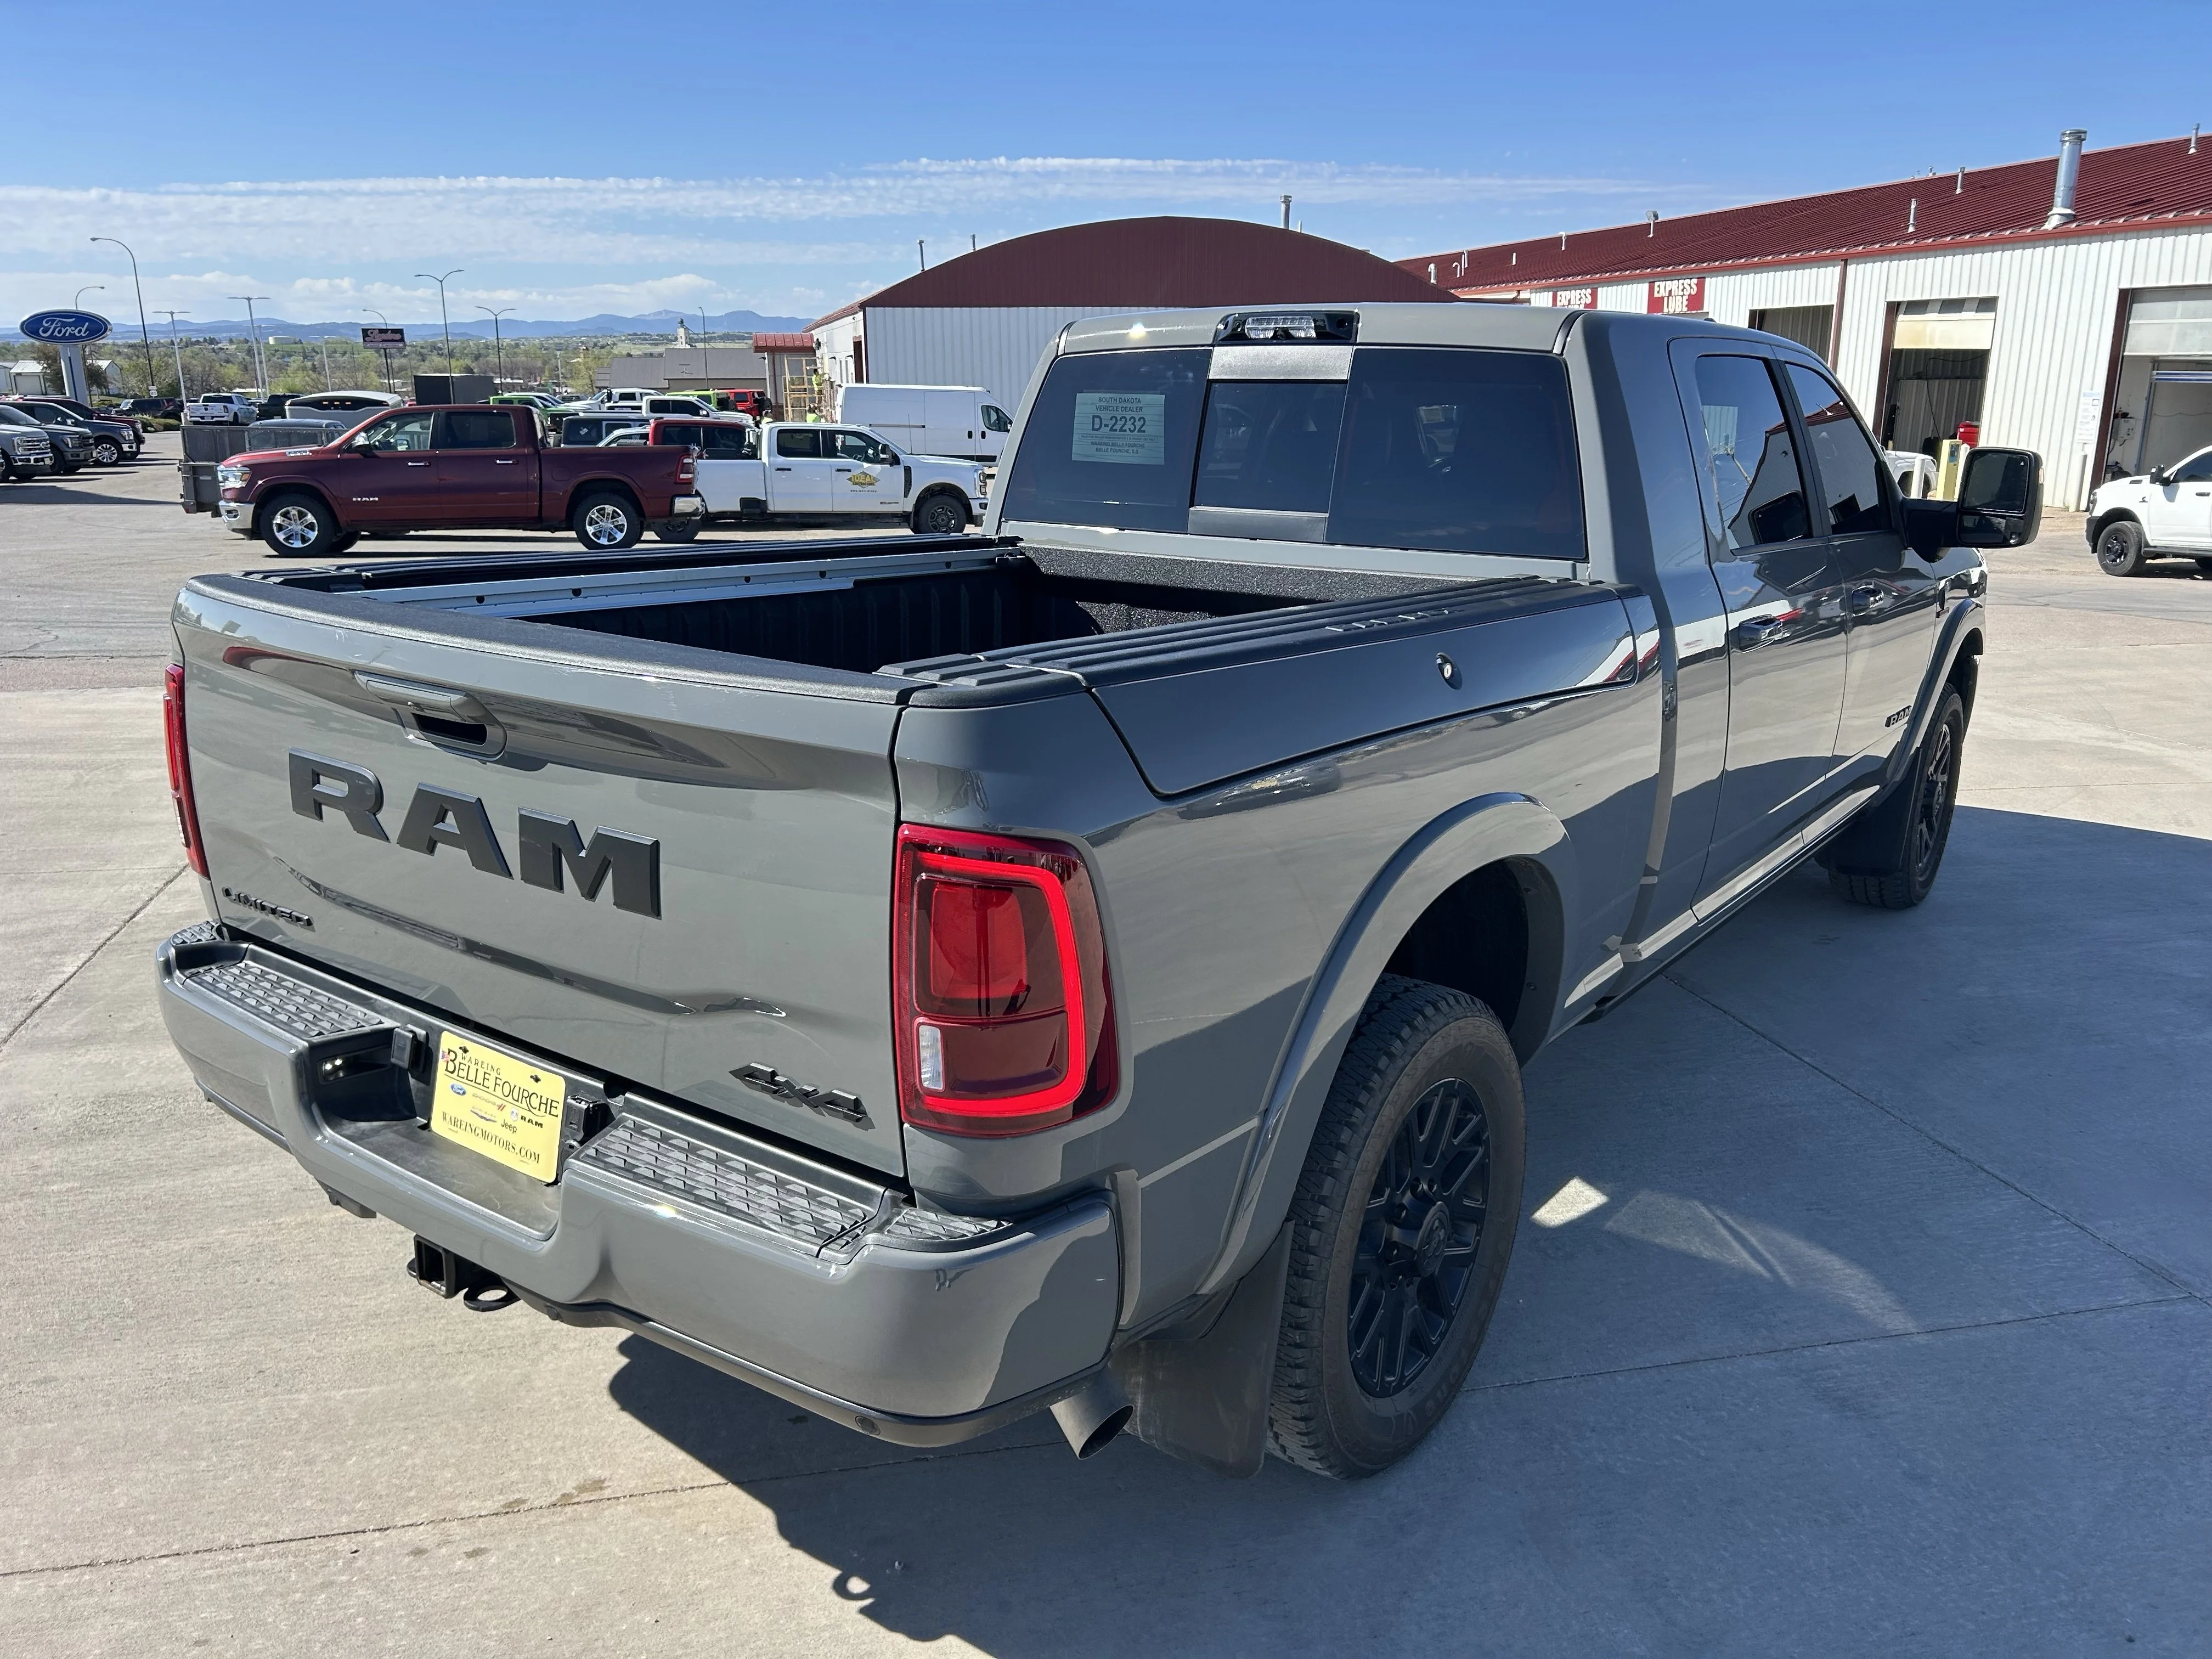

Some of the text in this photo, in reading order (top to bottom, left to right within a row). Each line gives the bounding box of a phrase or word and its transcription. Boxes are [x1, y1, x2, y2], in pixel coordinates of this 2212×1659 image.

[1557, 289, 1592, 306] EXPRESS
[1654, 279, 1697, 297] EXPRESS
[1663, 296, 1689, 313] LUBE
[39, 317, 89, 337] Ford
[1091, 415, 1146, 433] D-2232
[851, 474, 875, 483] IDEAL
[1884, 705, 1911, 727] RAM
[289, 747, 662, 920] RAM
[222, 887, 315, 931] LIMITED
[461, 1053, 501, 1075] WAREING
[445, 1048, 559, 1118] BELLE FOURCHE
[501, 1119, 517, 1134] Jeep
[521, 1115, 543, 1128] RAM
[442, 1111, 540, 1164] WAREINGMOTORS.COM
